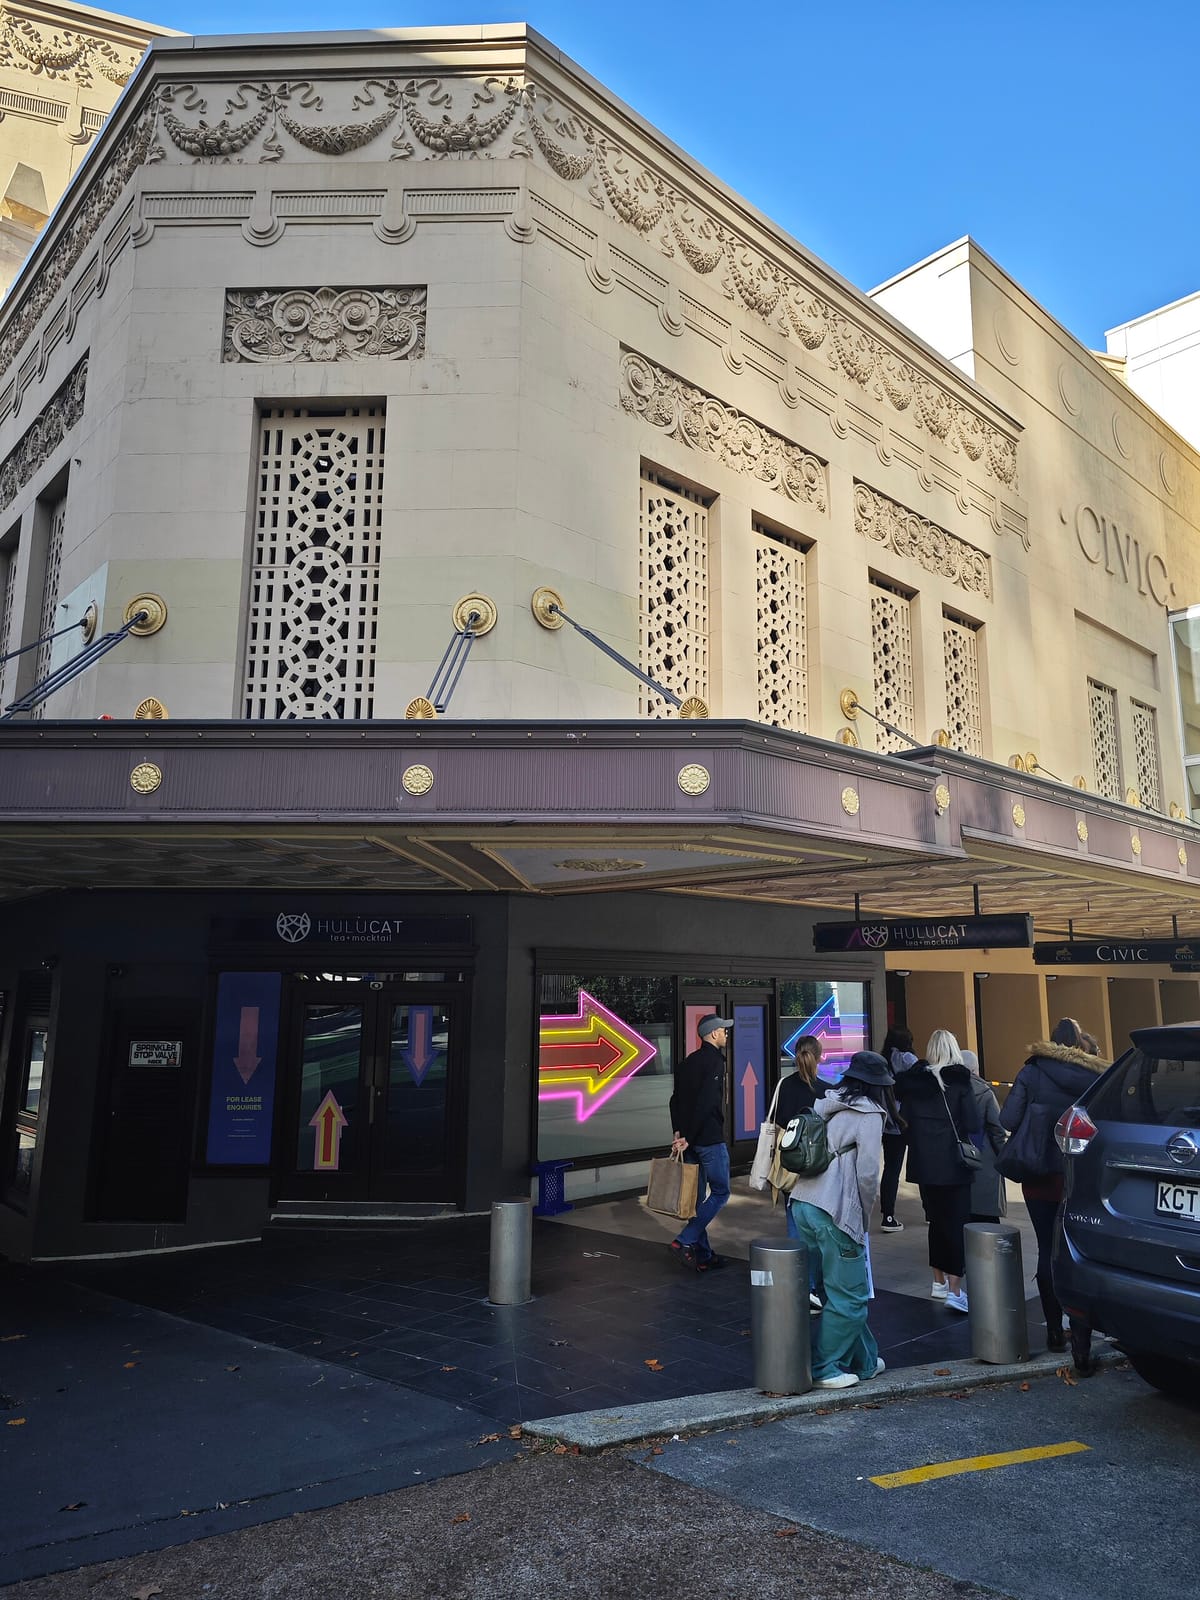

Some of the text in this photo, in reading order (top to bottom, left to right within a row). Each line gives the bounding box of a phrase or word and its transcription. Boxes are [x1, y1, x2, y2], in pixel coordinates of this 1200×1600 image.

[1074, 503, 1169, 607] CIVIC
[893, 923, 968, 940] HULUCAT
[1096, 945, 1149, 961] CIVIC
[133, 1051, 178, 1059] STOP VALVE
[135, 1044, 177, 1052] SPRINKLER
